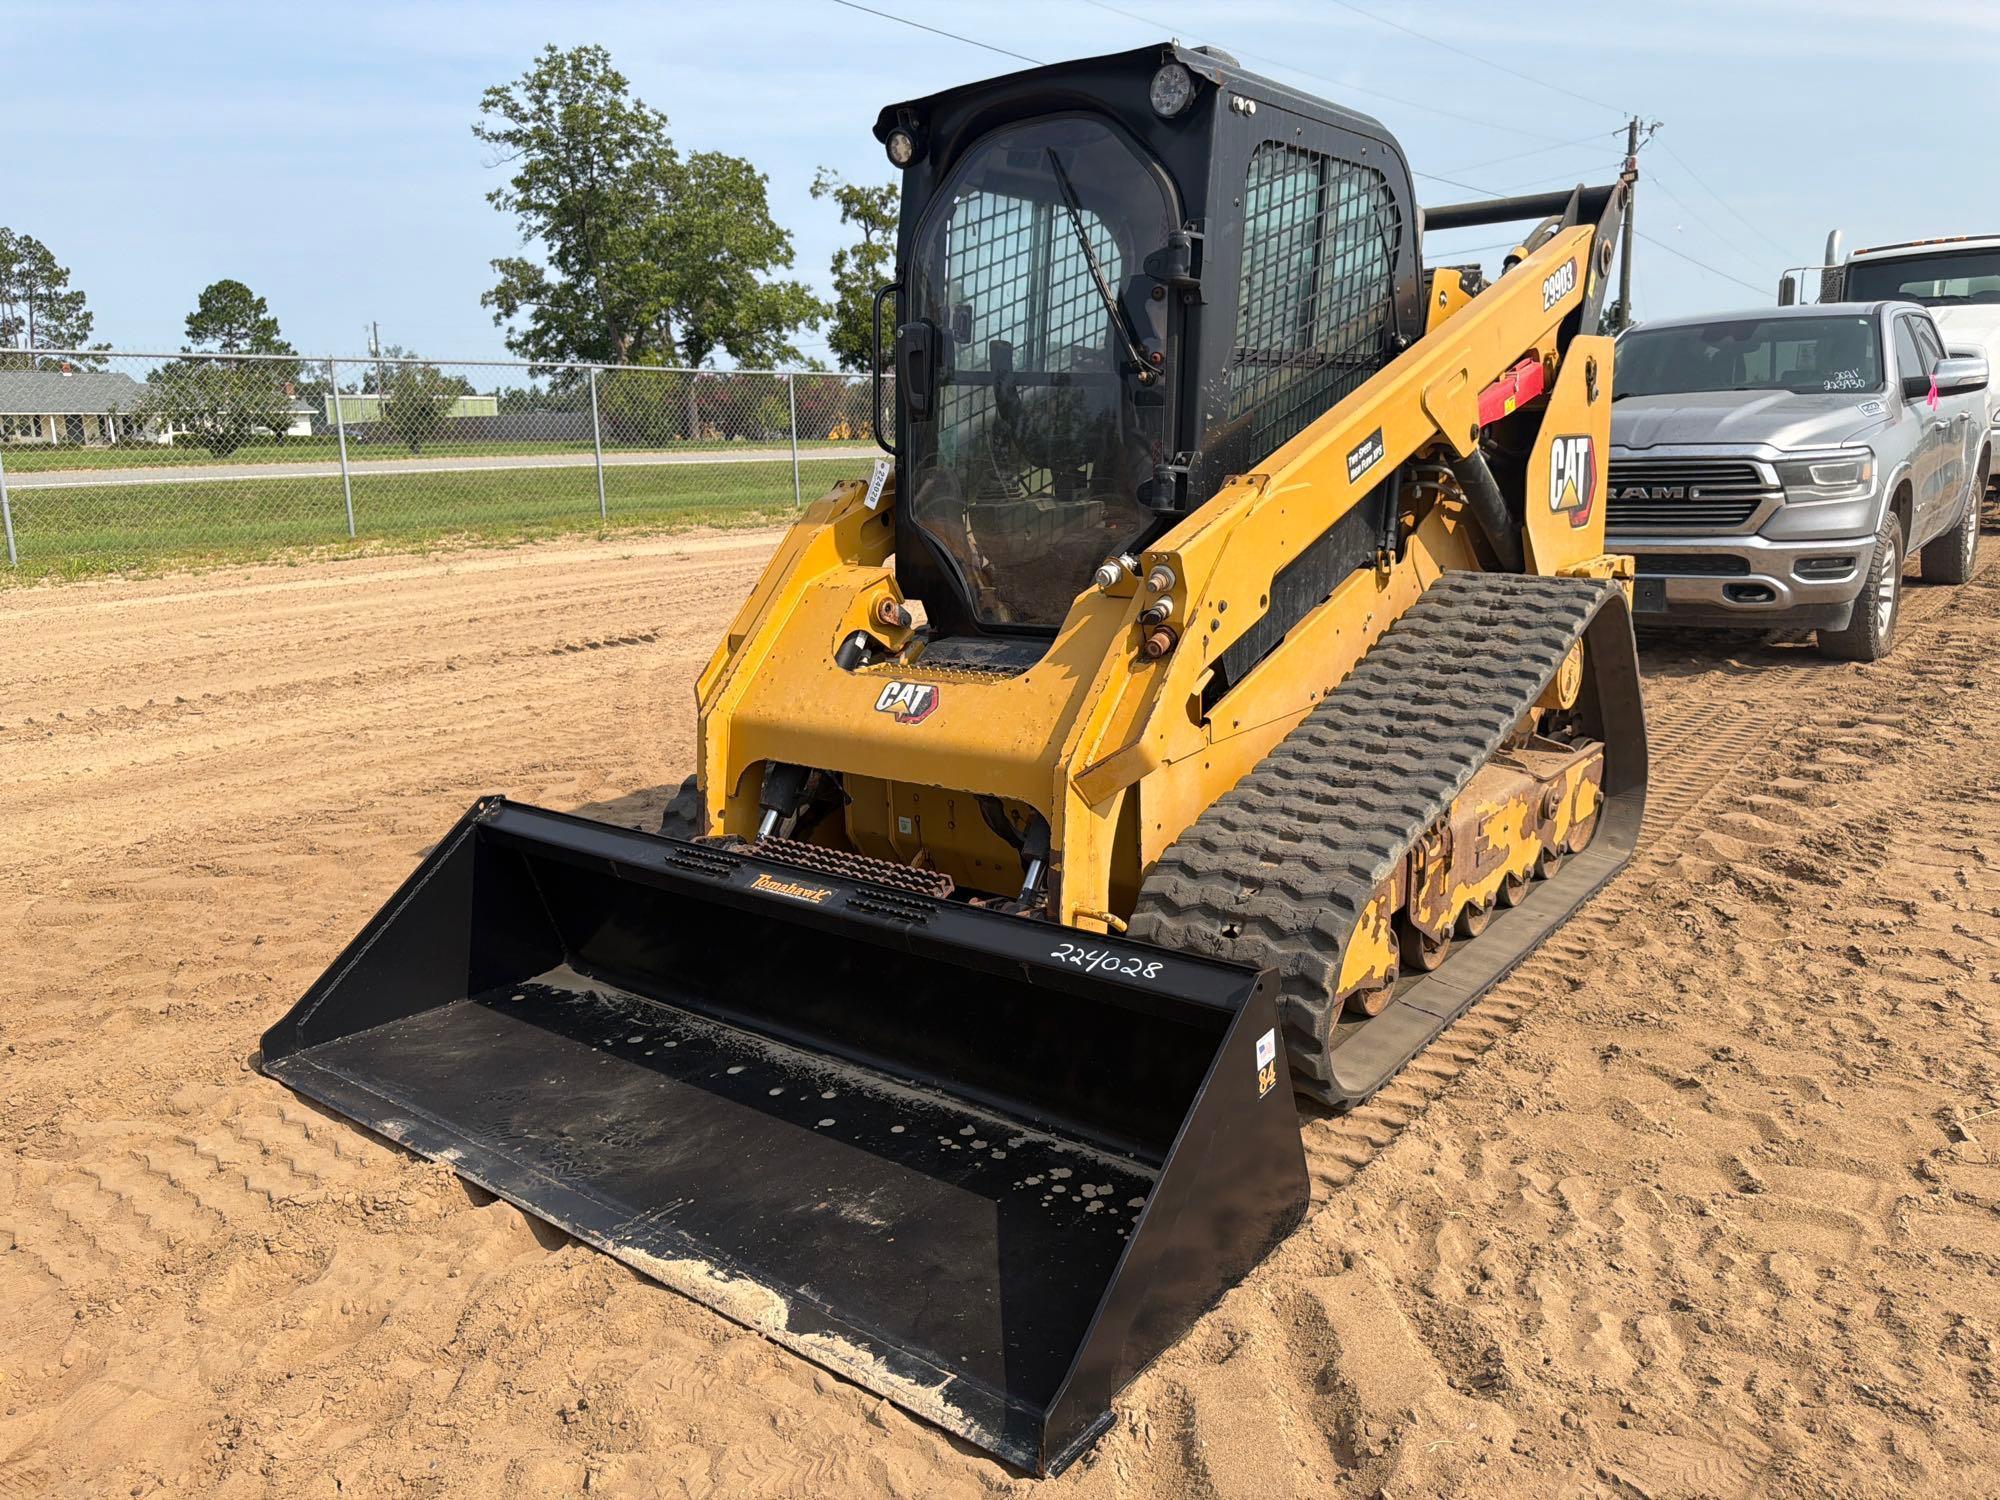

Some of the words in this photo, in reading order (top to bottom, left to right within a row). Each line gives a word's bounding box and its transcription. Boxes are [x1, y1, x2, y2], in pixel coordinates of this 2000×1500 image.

[1543, 260, 1573, 311] 299D3
[1823, 379, 1866, 391] 223930
[870, 470, 885, 503] 224028
[1550, 438, 1588, 510] CAT
[876, 681, 932, 714] CAT
[751, 873, 832, 901] Tomahawk
[1050, 943, 1164, 979] 224028
[1259, 1060, 1276, 1094] 84
